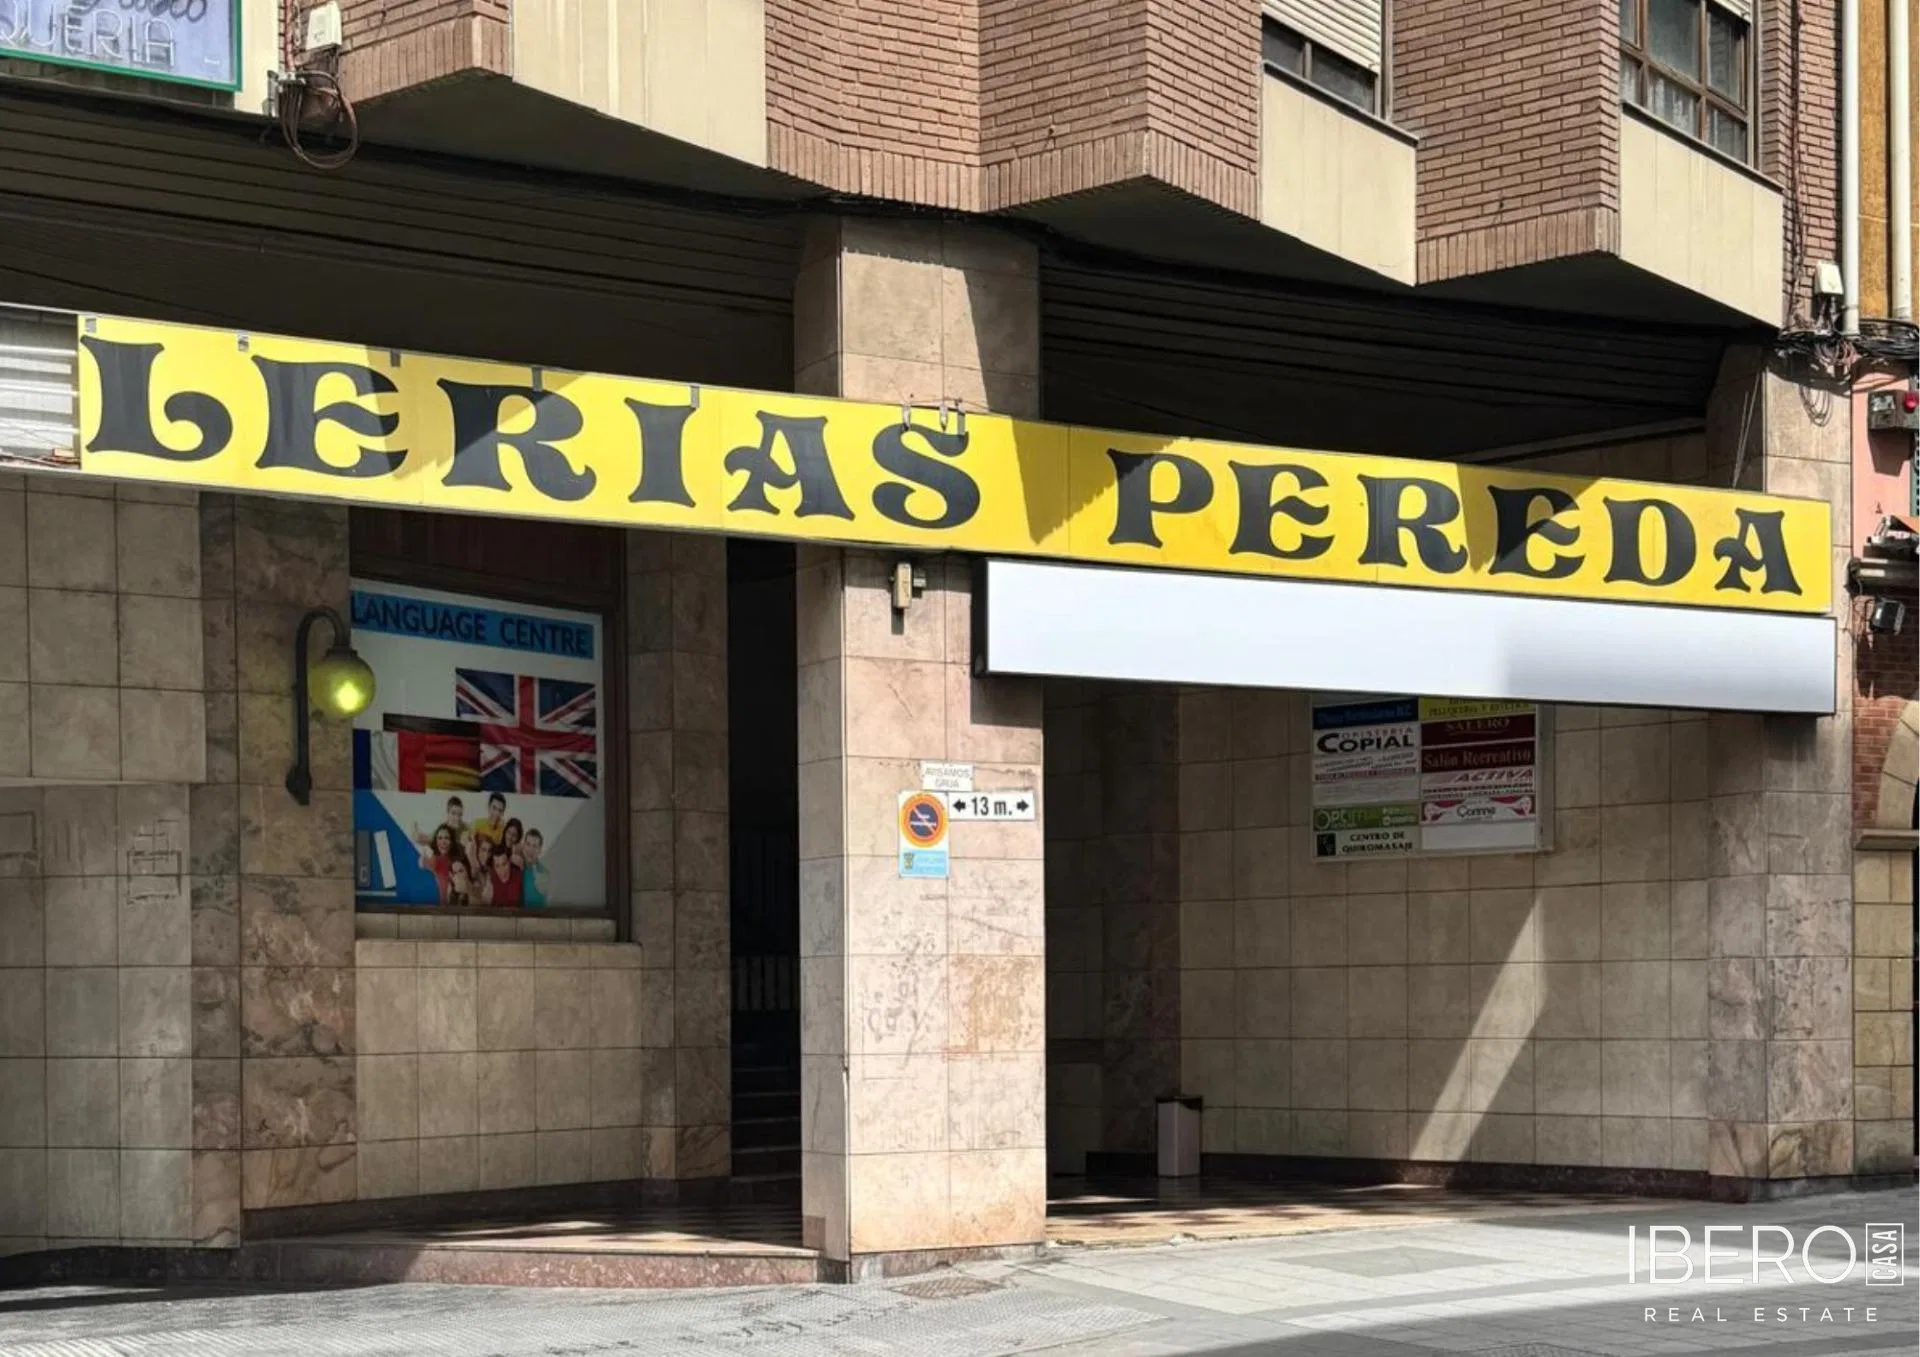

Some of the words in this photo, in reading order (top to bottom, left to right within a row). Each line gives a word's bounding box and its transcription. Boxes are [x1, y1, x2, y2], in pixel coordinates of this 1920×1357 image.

[80, 335, 981, 528] LERIAS
[1106, 446, 1802, 595] PEREDA
[351, 592, 486, 641] LANGUAGE
[500, 618, 589, 654] CENTRE
[1317, 732, 1415, 753] COPIAL
[970, 796, 989, 816] 13
[994, 799, 1013, 816] m.
[1349, 832, 1390, 842] CENTRO
[1392, 831, 1405, 840] DE
